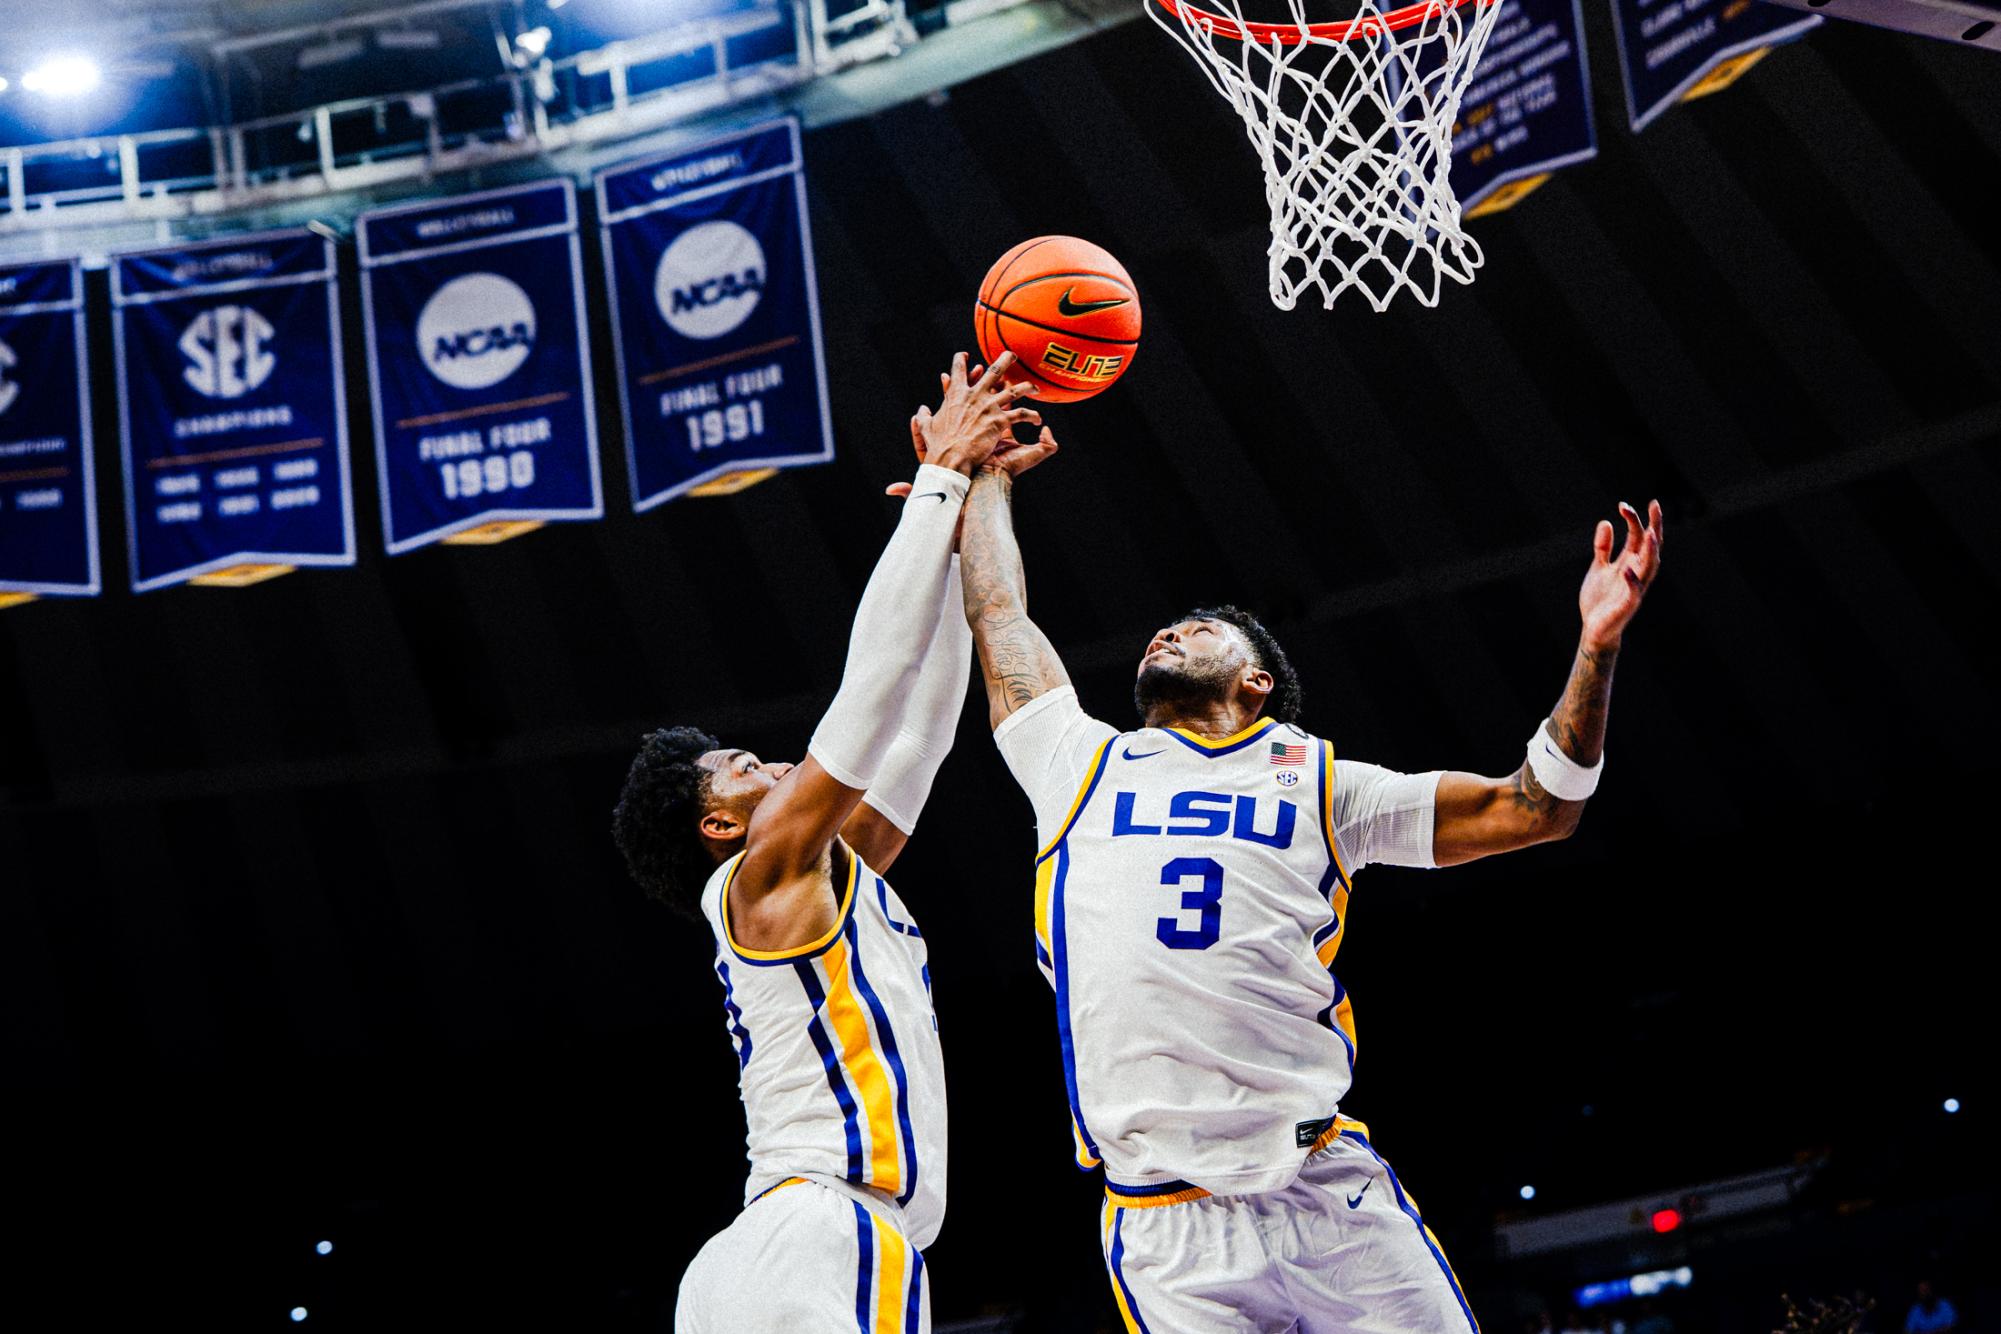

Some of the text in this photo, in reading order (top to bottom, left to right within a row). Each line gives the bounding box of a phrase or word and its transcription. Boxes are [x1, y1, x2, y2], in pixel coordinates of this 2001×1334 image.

[672, 268, 766, 315] NCAA
[178, 304, 277, 398] SEC
[434, 321, 534, 363] NCAA
[1042, 341, 1124, 377] ELITE
[660, 364, 783, 416] FINAL FOUR
[419, 417, 551, 461] FINAL FOUR
[686, 400, 764, 451] 1991
[441, 450, 536, 500] 1990
[1112, 791, 1297, 850] LSU
[1156, 857, 1224, 950] 3
